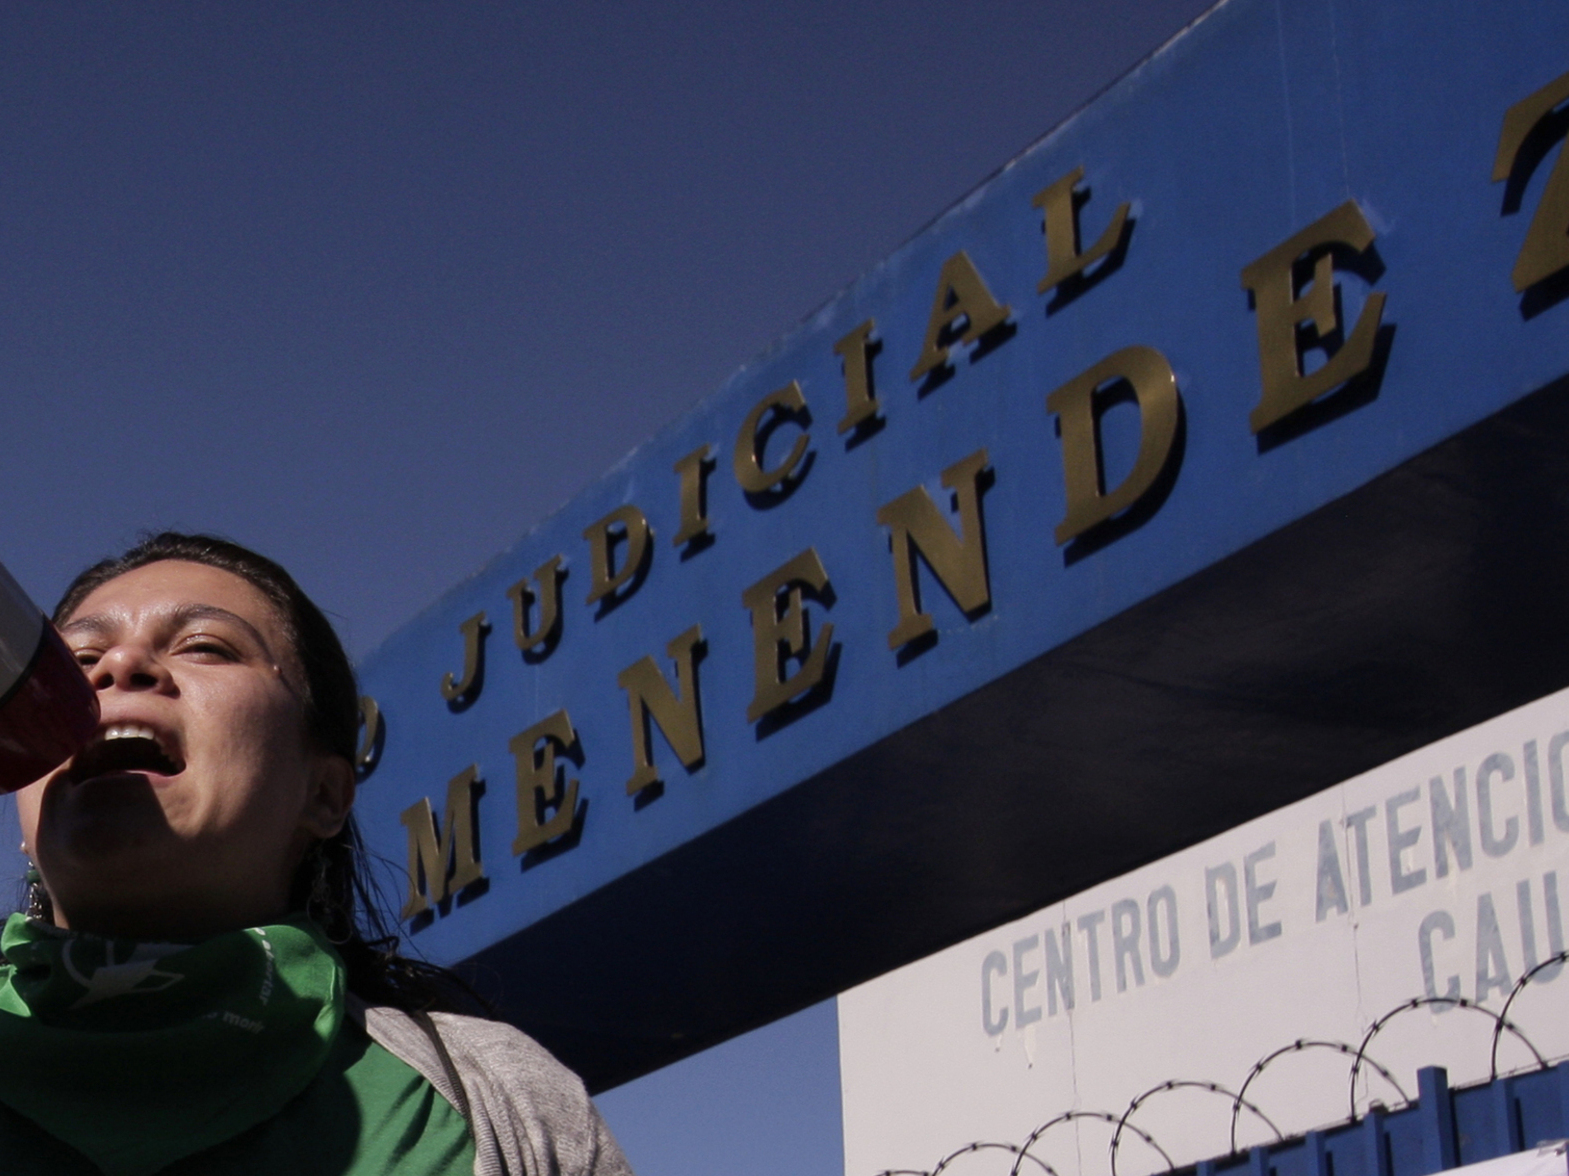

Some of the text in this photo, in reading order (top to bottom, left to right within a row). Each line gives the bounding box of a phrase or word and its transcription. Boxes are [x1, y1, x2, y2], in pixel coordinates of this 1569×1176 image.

[441, 165, 1129, 700] JUDICIAL
[981, 884, 1180, 1037] CENTRO
[1205, 842, 1283, 958] DE
